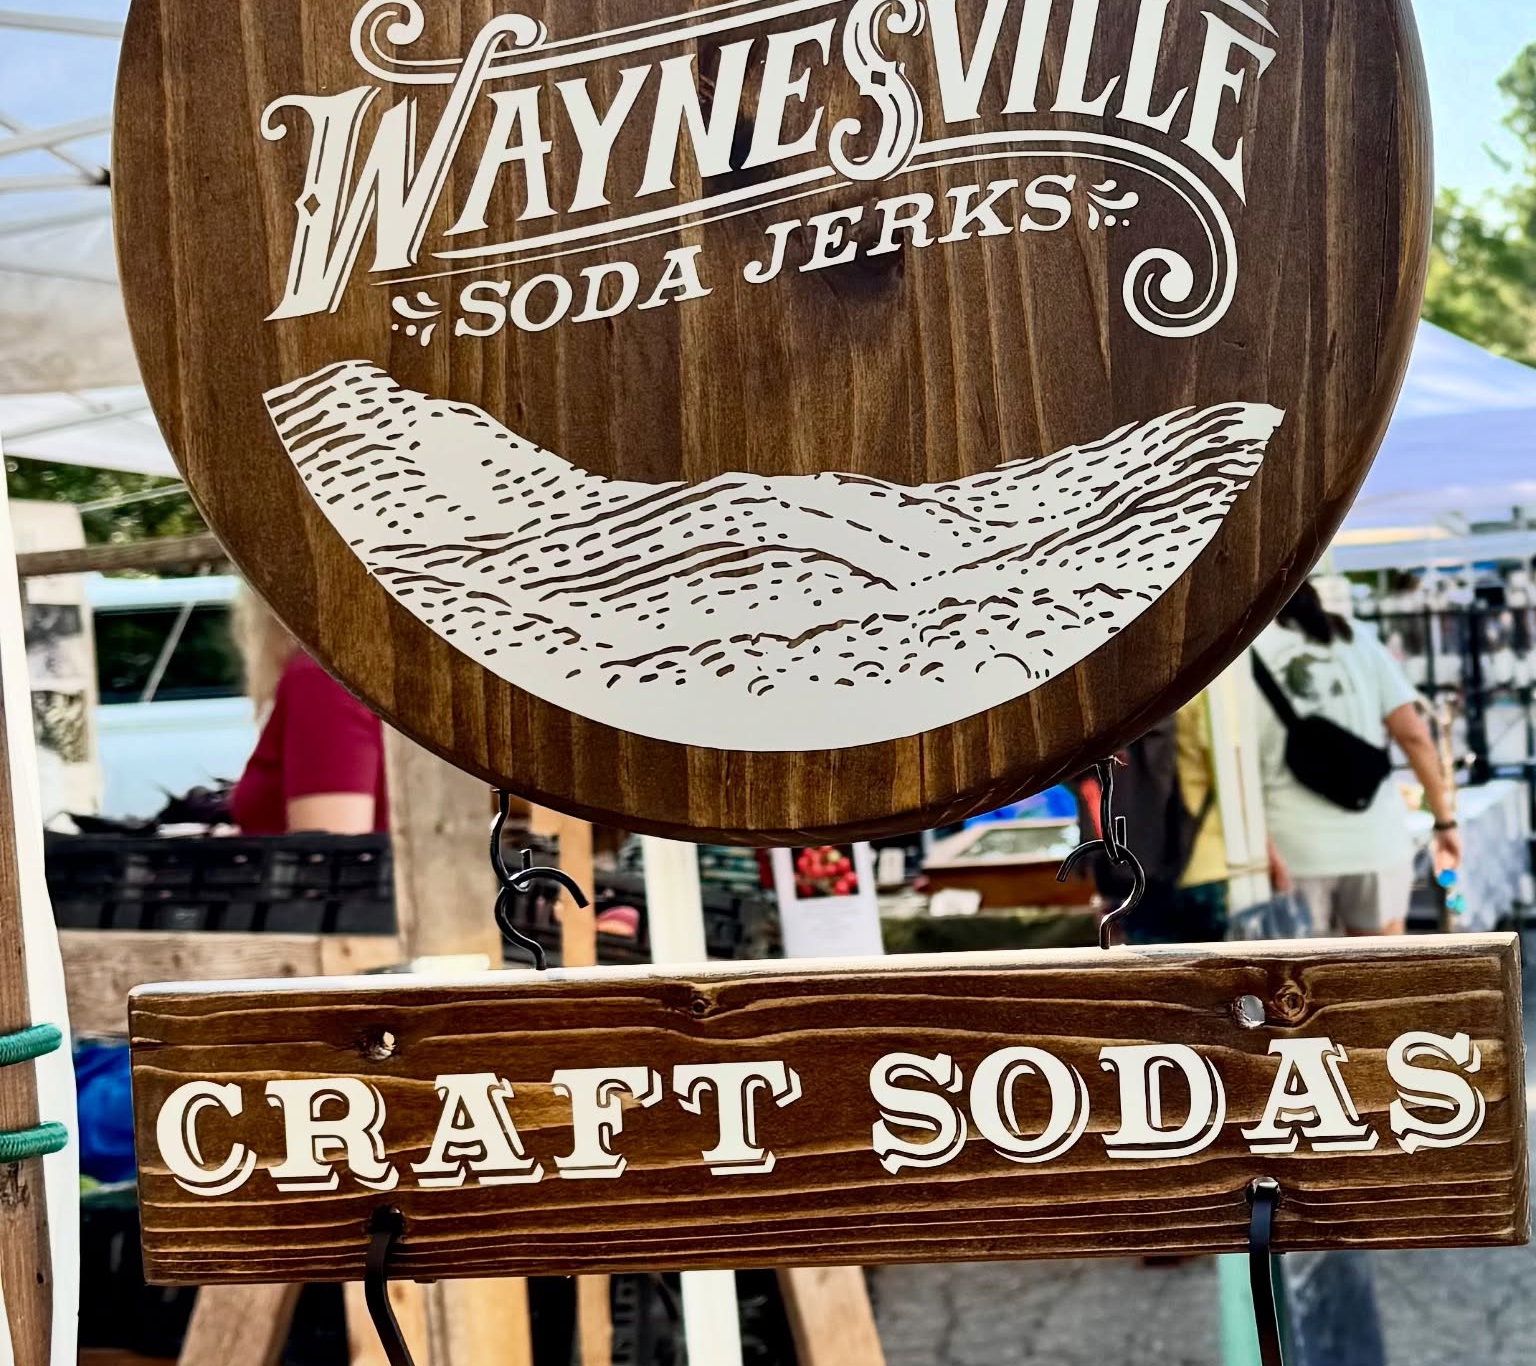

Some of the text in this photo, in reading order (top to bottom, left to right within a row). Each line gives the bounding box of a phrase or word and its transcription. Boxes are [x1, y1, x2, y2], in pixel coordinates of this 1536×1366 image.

[454, 172, 1077, 337] SODA JERKS
[156, 1031, 1486, 1197] CRAFT SODAS
